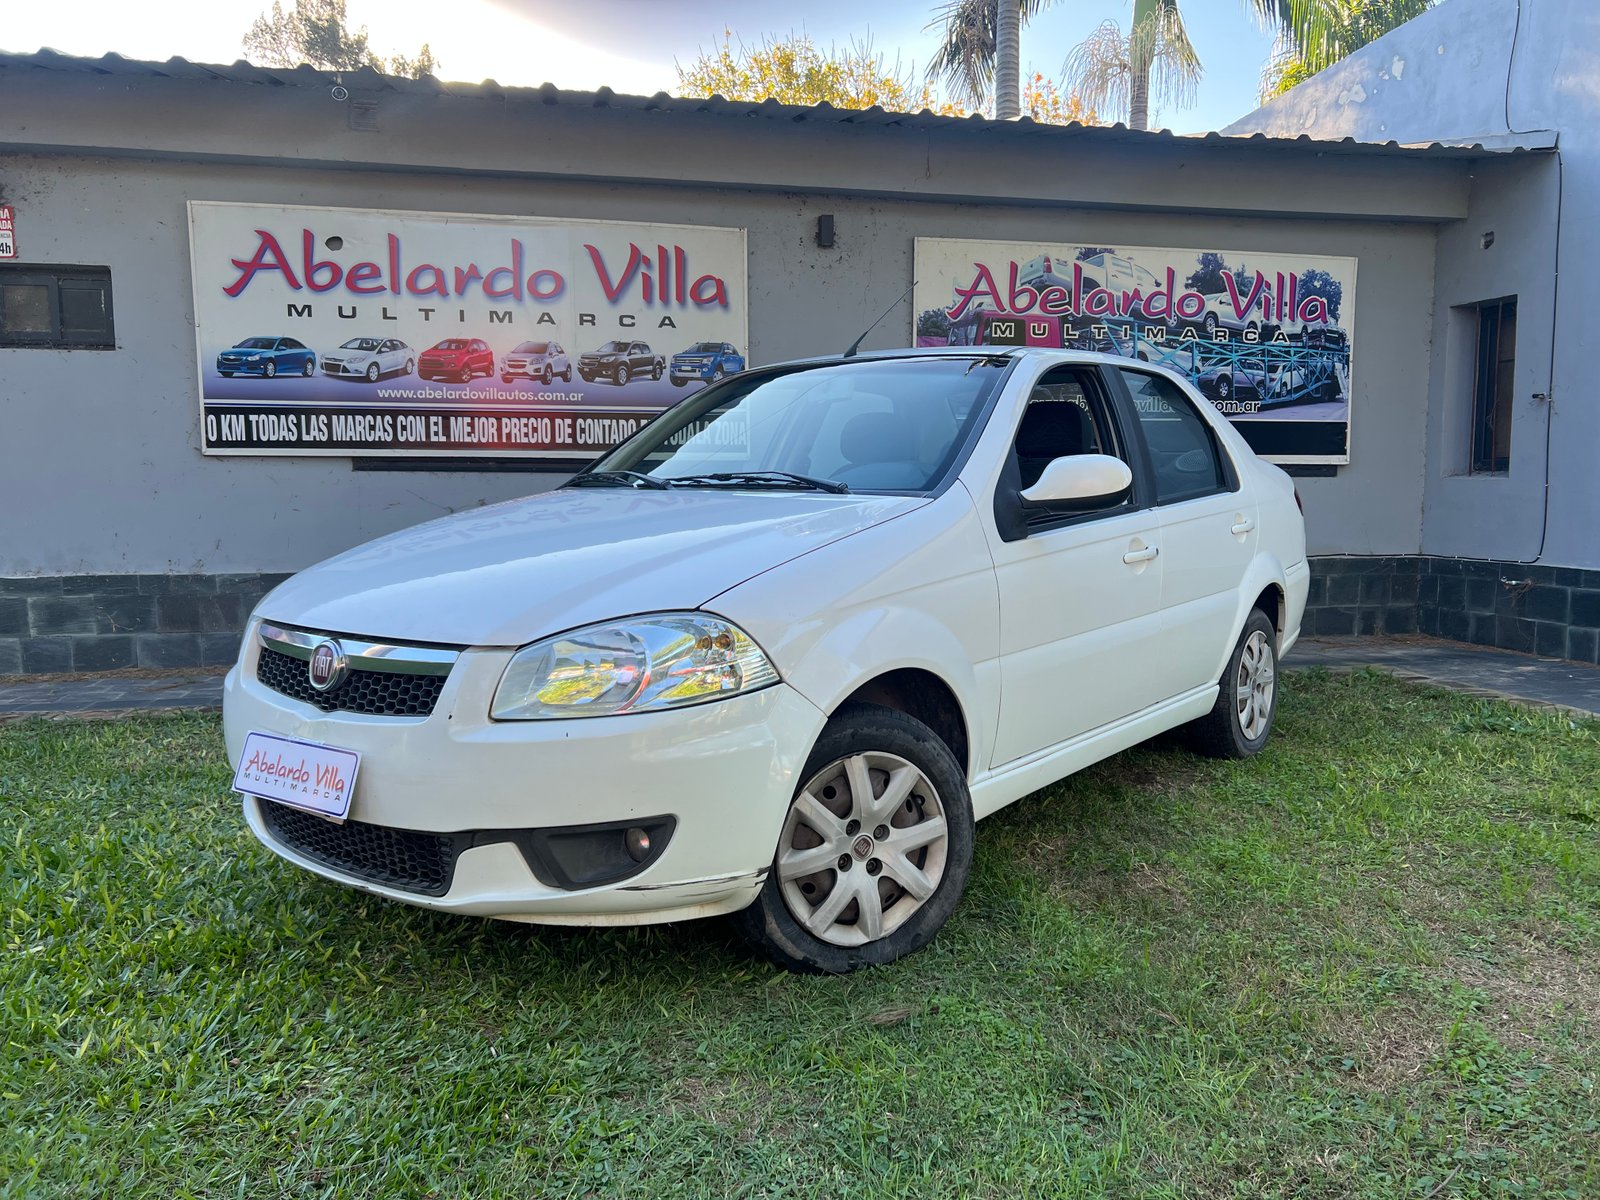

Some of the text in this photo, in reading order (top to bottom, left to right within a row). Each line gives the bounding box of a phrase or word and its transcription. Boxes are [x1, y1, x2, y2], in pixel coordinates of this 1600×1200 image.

[222, 229, 728, 307] Abelardo Villa
[947, 261, 1329, 325] Abelardo Villa
[287, 303, 677, 328] MULTIMARCA
[991, 322, 1291, 344] MULTIMARCA
[377, 386, 584, 402] www.abelardovillautos.com.ar
[220, 414, 246, 441] KM
[249, 414, 298, 442] TODAS
[301, 414, 328, 442] LAS
[331, 415, 394, 442] MARCAS
[397, 415, 426, 442] CON
[429, 416, 447, 442] EL
[450, 416, 498, 443] MEJOR
[501, 417, 552, 444] PRECIO
[555, 418, 573, 444] DE
[576, 418, 637, 445] CONTADO
[714, 421, 747, 446] ZONA
[313, 655, 332, 677] FIAT
[244, 750, 345, 793] Abelardo Villa
[243, 772, 342, 802] MULTIMARCA
